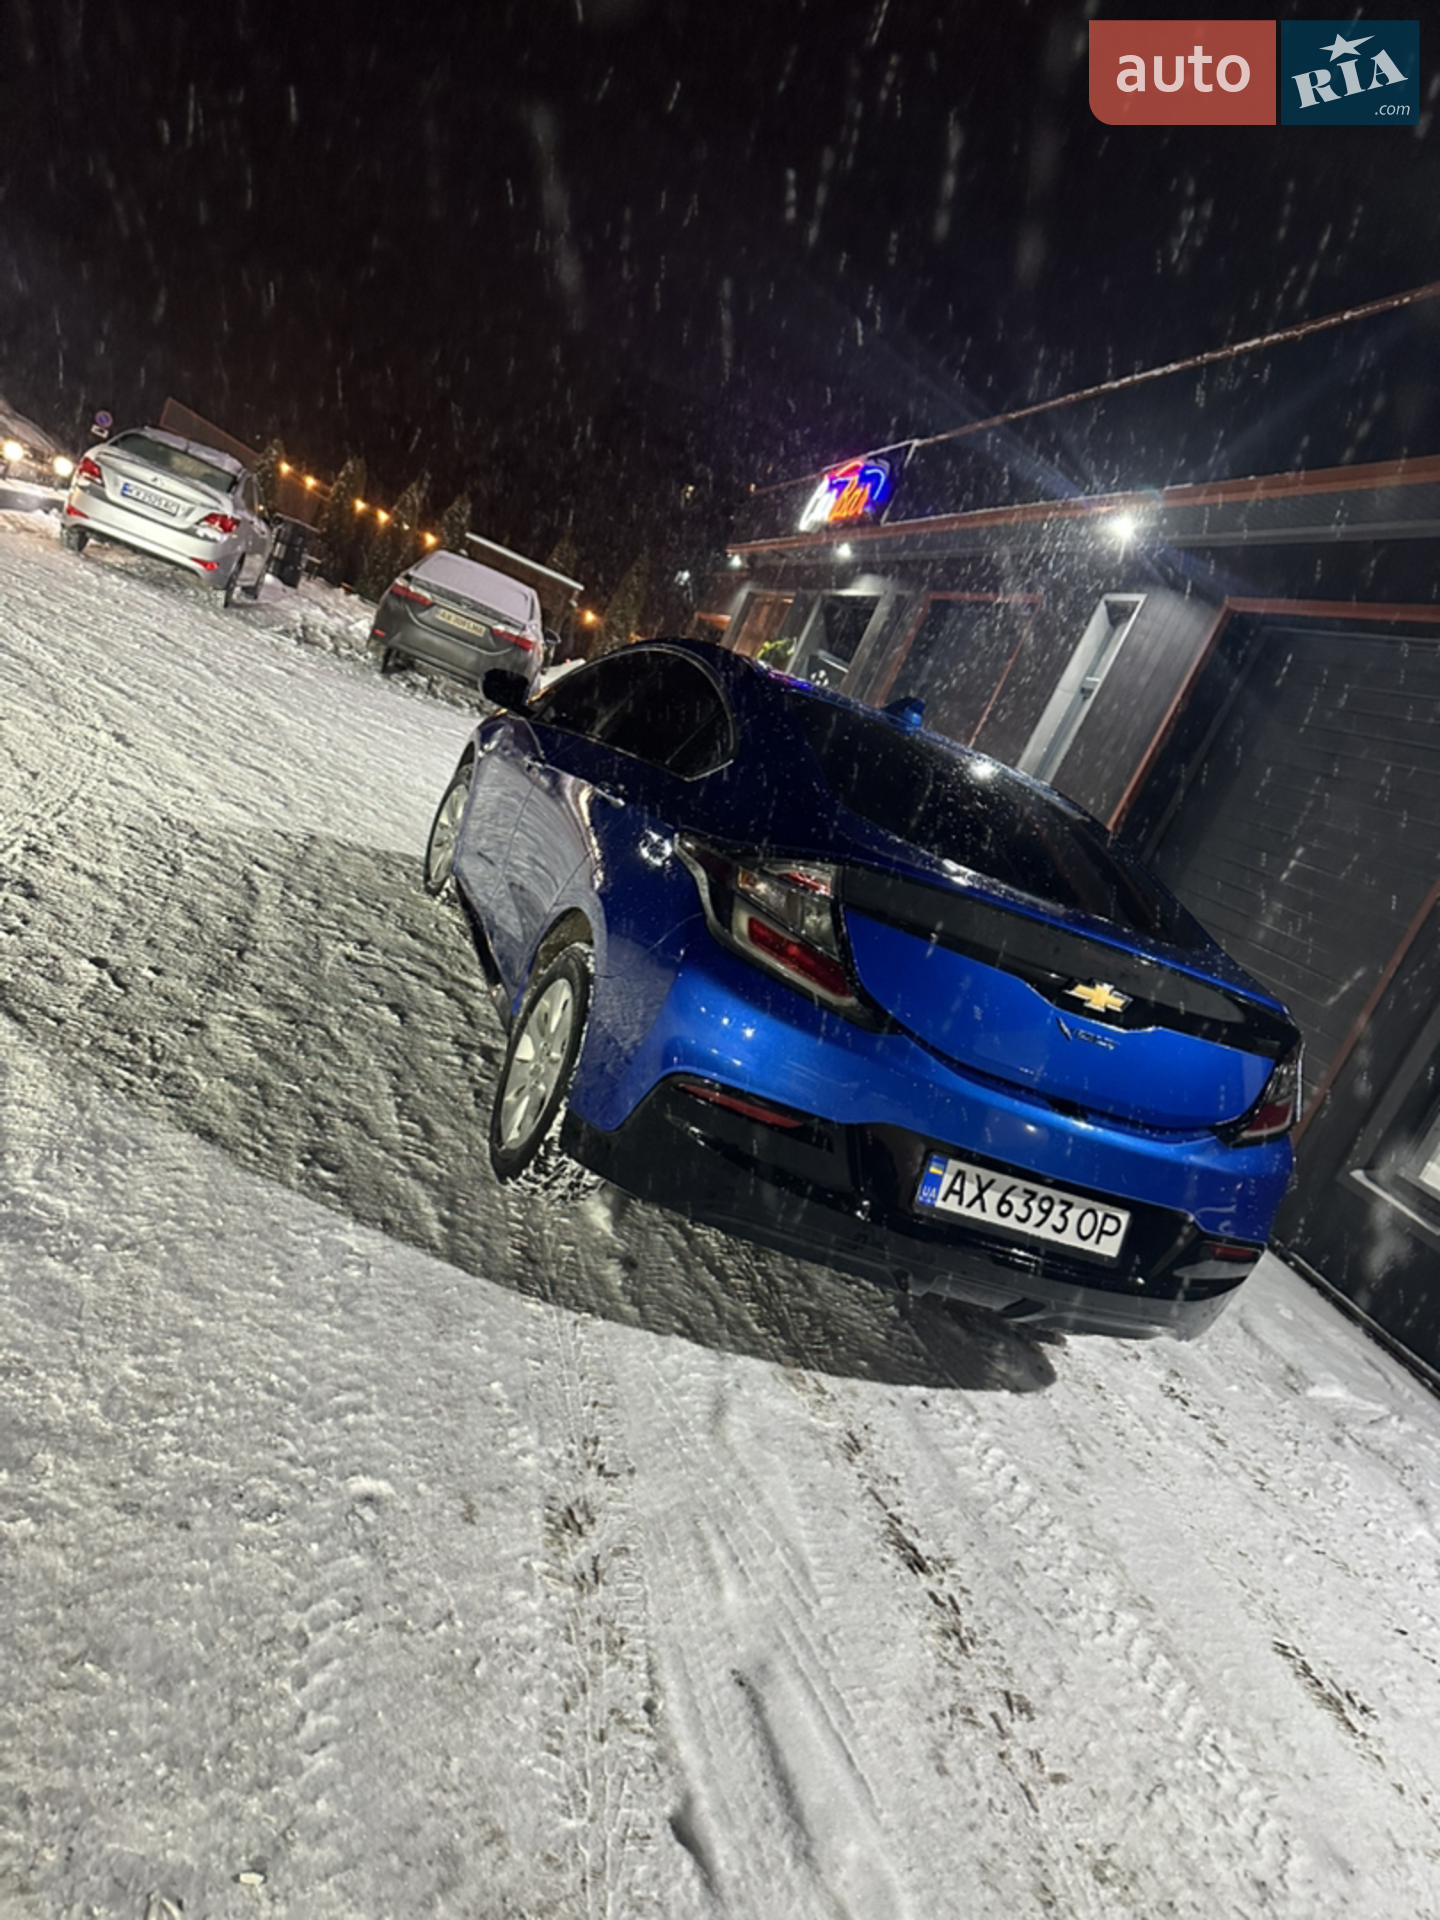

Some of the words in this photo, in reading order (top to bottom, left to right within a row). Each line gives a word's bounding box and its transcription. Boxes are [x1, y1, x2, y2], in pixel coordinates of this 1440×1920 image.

[921, 1185, 937, 1199] UA
[941, 1168, 996, 1214] AX
[996, 1185, 1074, 1235] 6393
[1076, 1208, 1122, 1245] OP
